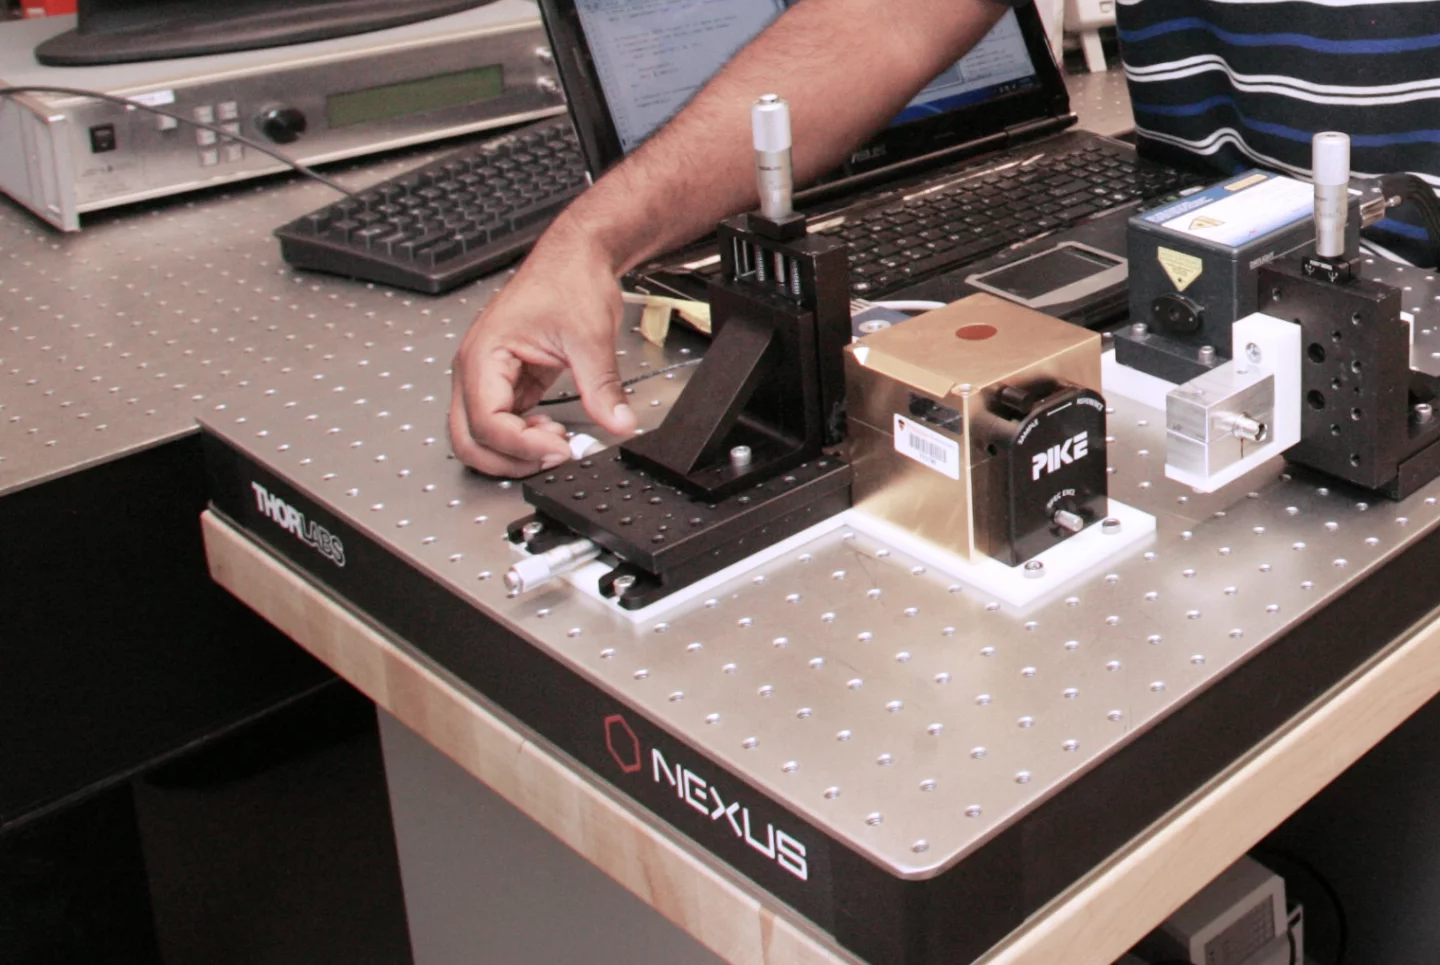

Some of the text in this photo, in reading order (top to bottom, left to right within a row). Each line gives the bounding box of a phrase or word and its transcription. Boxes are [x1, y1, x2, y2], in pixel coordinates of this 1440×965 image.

[1017, 418, 1039, 445] SAMPLE
[1031, 430, 1088, 481] PIKE
[251, 480, 346, 567] THORLABS
[651, 747, 808, 881] NEXUS
